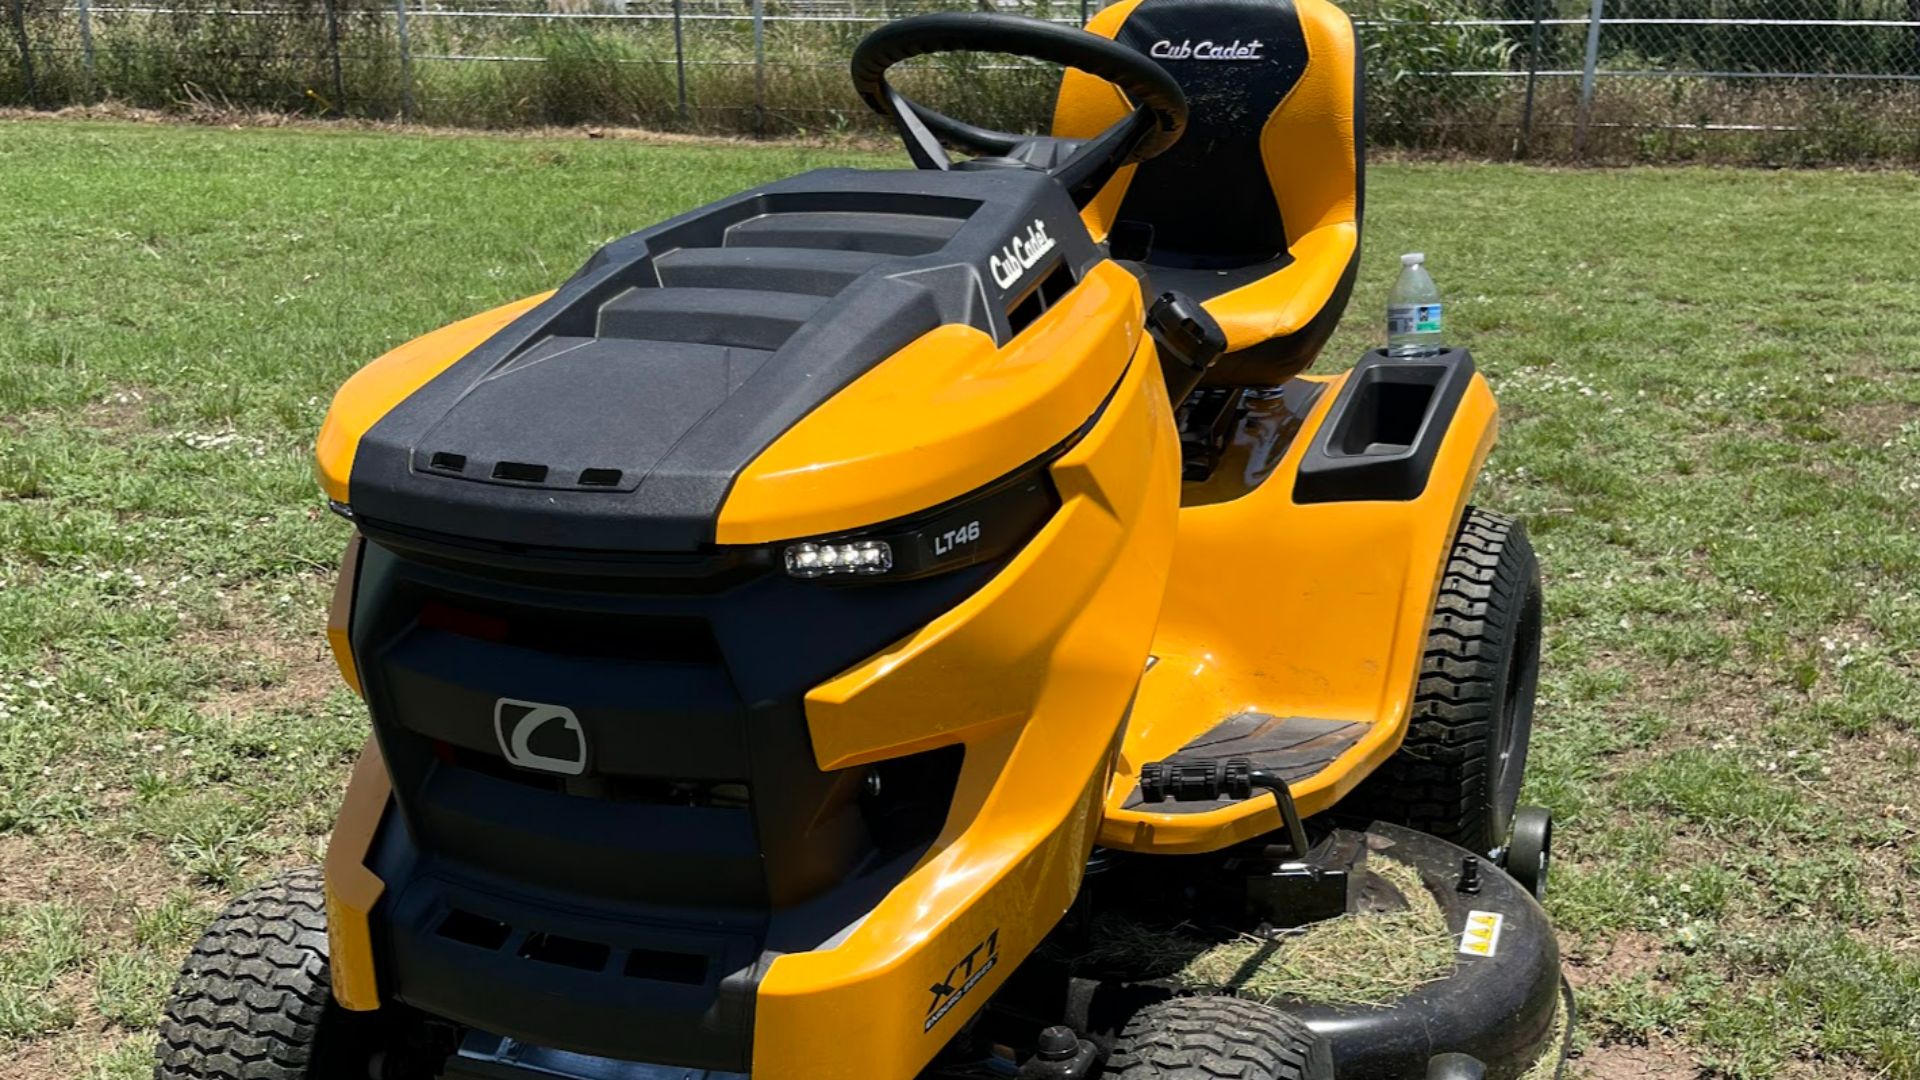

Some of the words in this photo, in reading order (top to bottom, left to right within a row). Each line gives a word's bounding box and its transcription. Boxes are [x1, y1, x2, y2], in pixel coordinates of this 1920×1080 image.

[1150, 40, 1192, 59] Cub
[1193, 40, 1264, 60] Cadet
[989, 246, 1023, 290] Cub
[1012, 218, 1057, 269] Cadet
[934, 521, 980, 556] LT46
[926, 927, 1000, 1015] XT1
